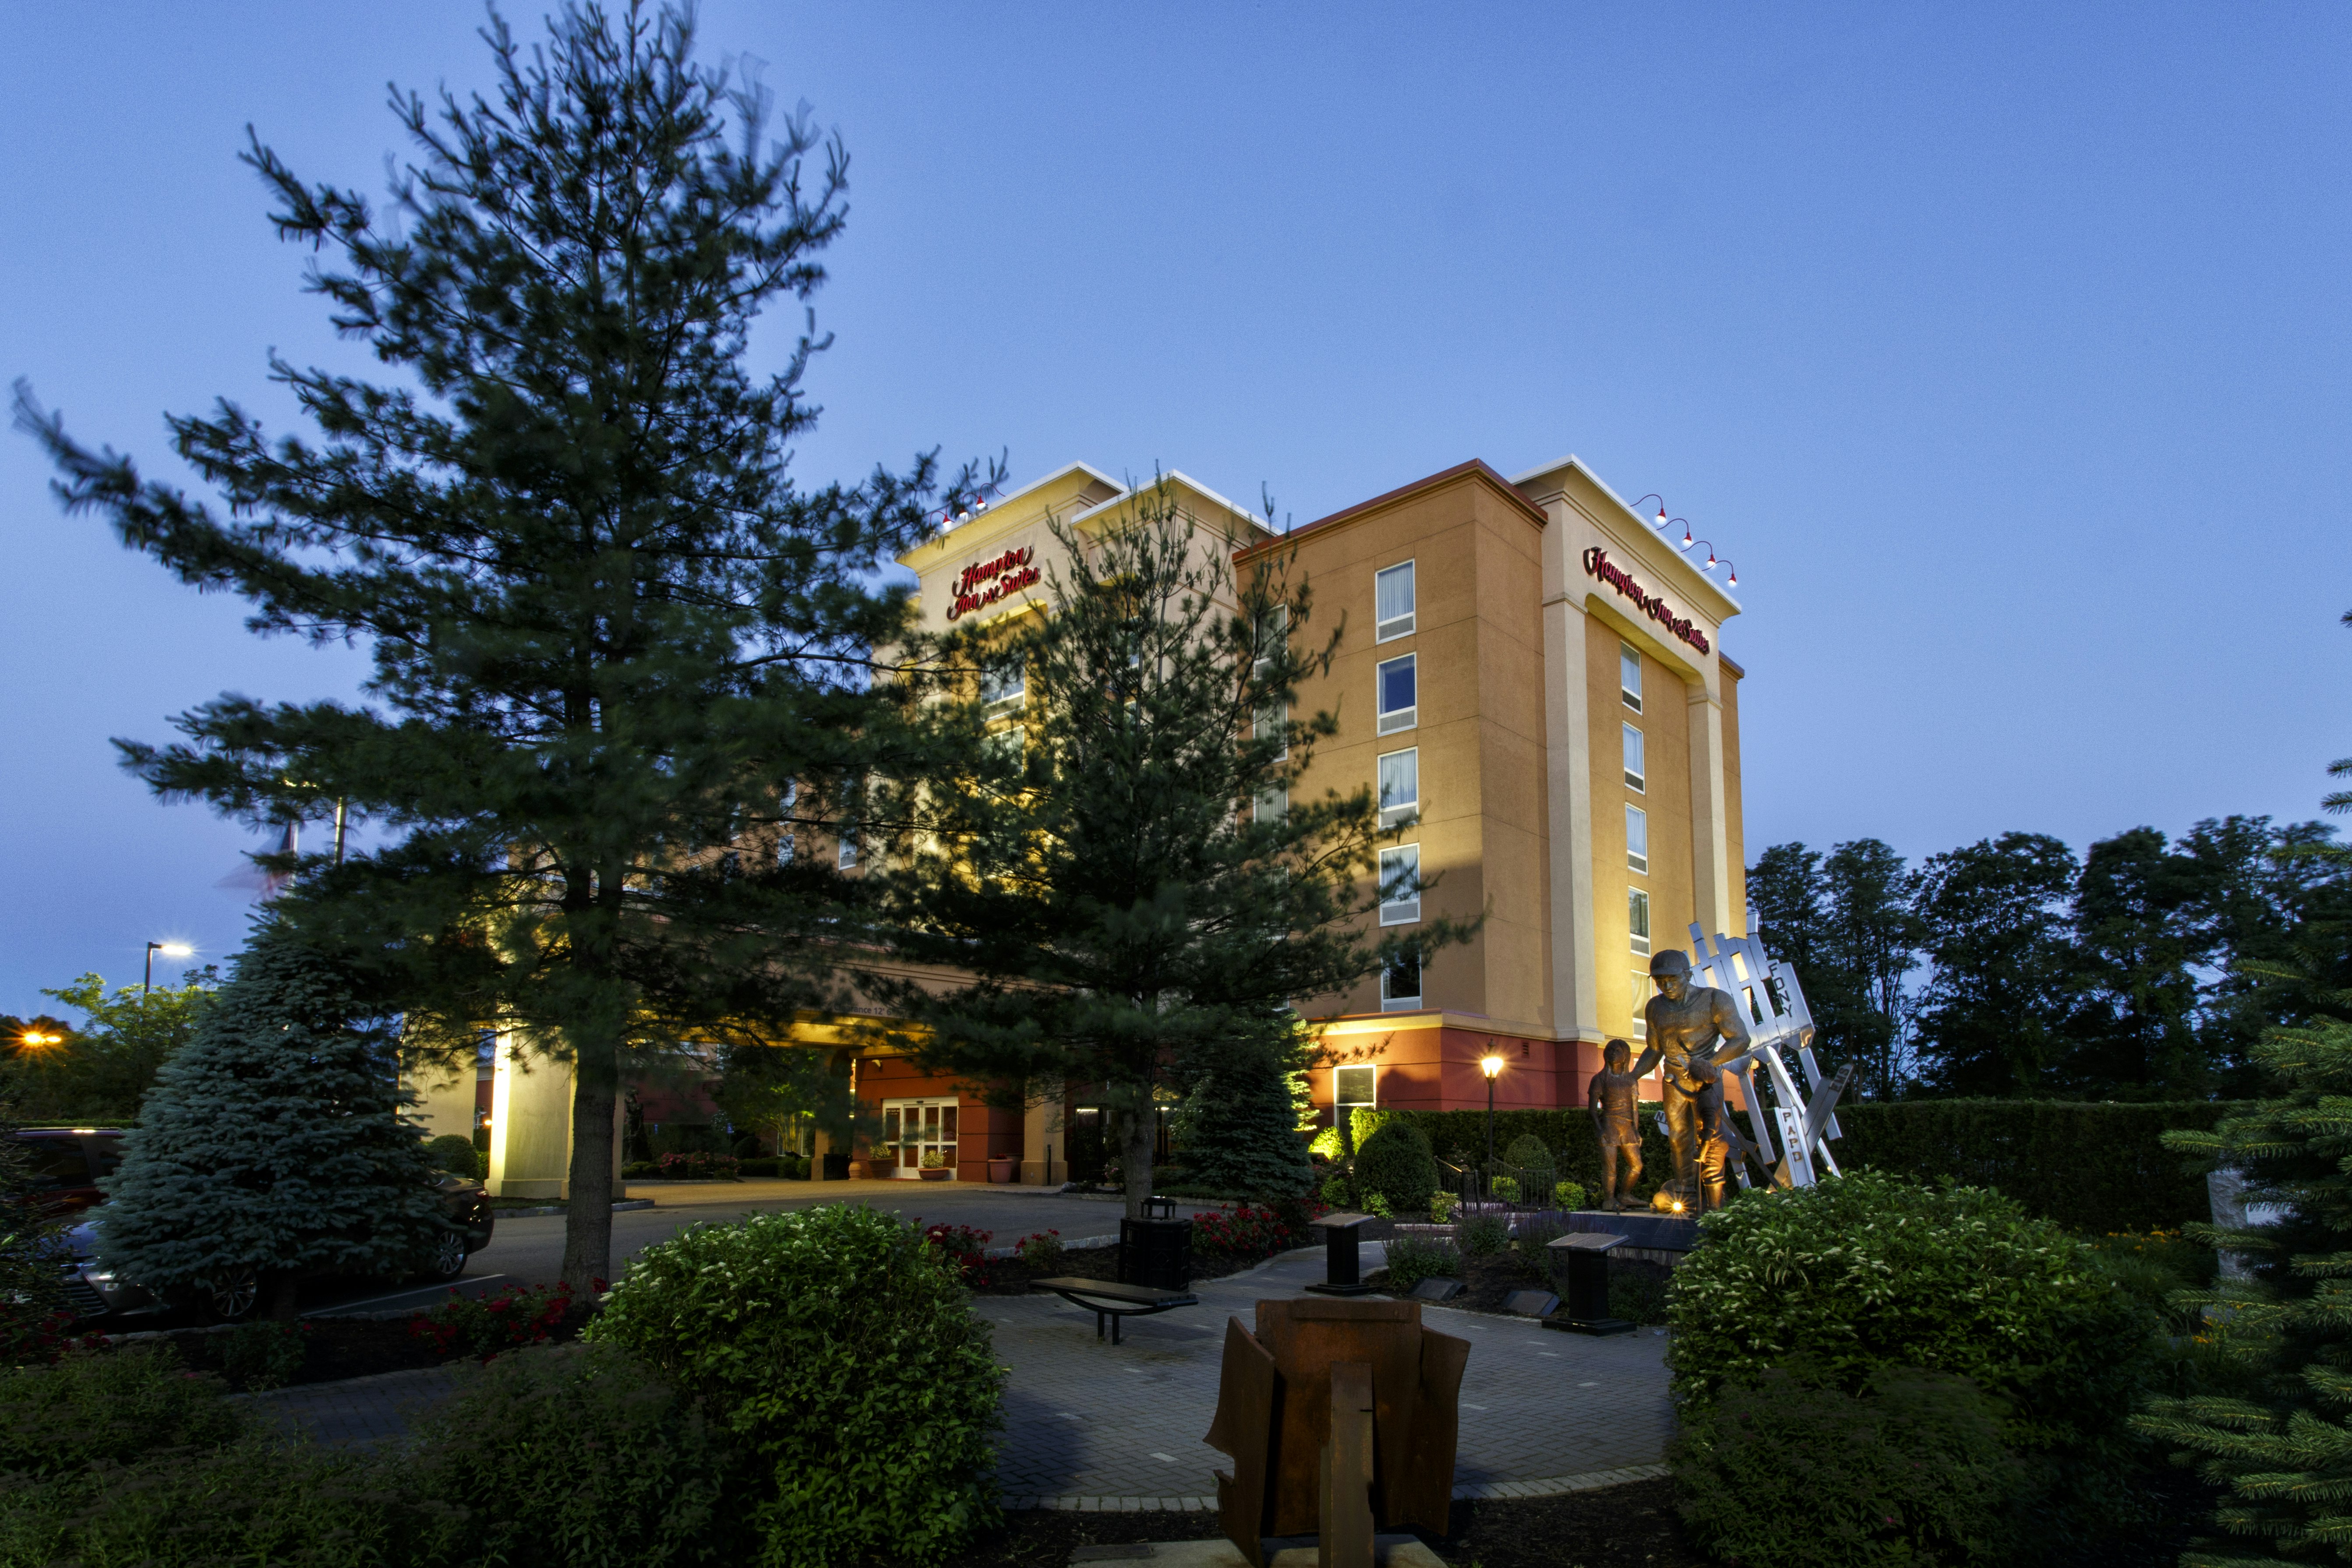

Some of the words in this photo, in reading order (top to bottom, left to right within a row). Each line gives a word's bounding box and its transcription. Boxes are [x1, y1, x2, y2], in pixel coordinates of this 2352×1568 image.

[946, 592, 985, 621] Inn
[983, 587, 997, 603] &
[994, 567, 1041, 598] Suites
[952, 546, 1034, 597] Hampton
[1583, 547, 1648, 611] Hampton
[1647, 597, 1677, 632] Inn
[1682, 619, 1710, 655] Suites
[1768, 962, 1792, 1018] FDNY
[1830, 1067, 1850, 1093] EMS
[1783, 1112, 1803, 1162] PAPD
